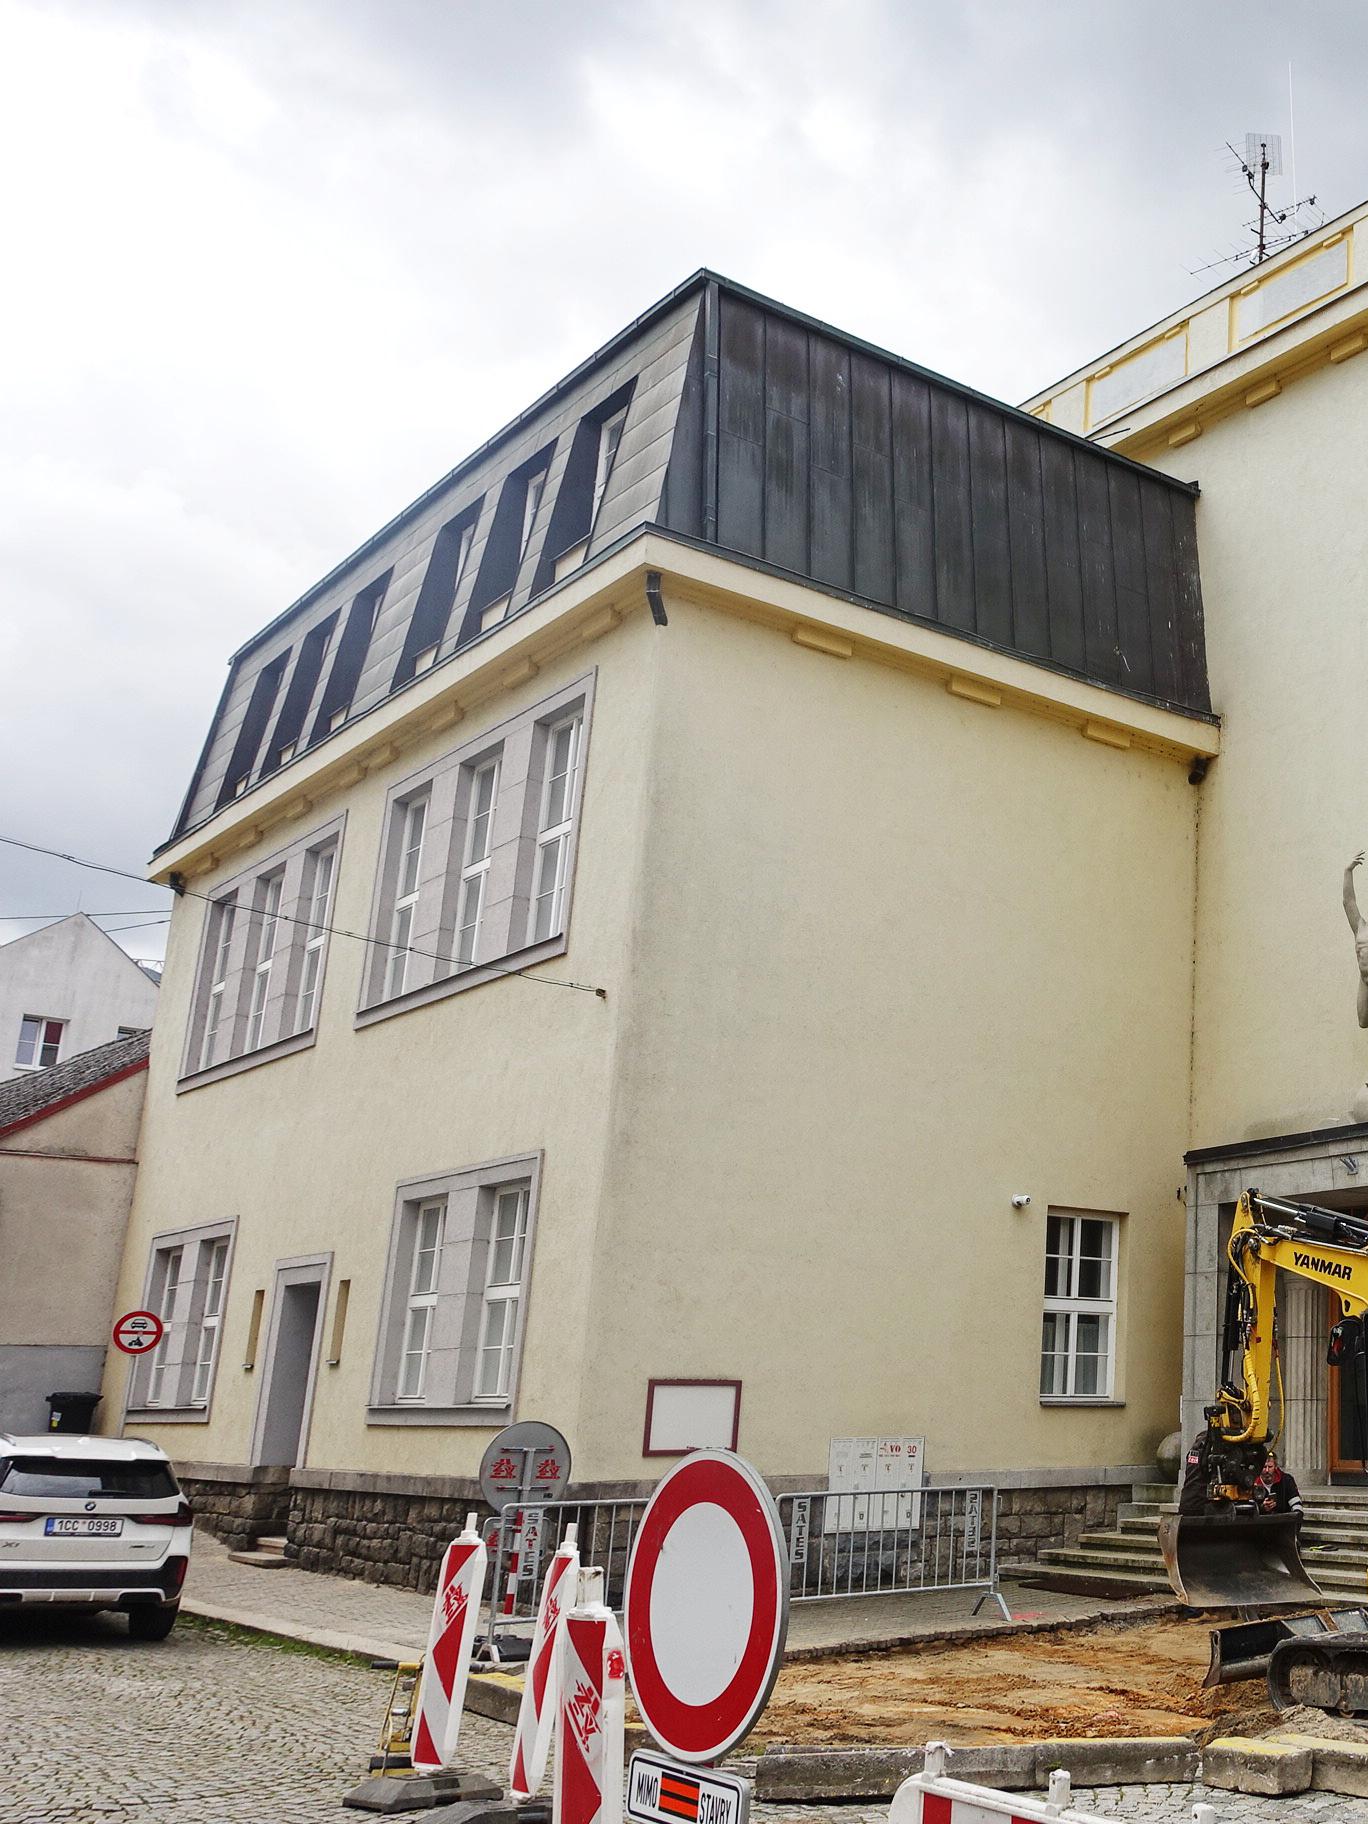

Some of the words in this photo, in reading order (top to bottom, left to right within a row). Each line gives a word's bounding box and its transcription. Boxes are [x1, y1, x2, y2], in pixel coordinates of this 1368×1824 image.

[1293, 1251, 1353, 1281] YANMAR
[907, 1445, 917, 1454] 30
[58, 1520, 80, 1531] 1CC
[88, 1520, 117, 1531] 0998
[794, 1501, 807, 1560] SATES
[521, 1512, 539, 1577] SATES
[635, 1771, 659, 1809] MIMO
[699, 1792, 732, 1824] STAVBY
